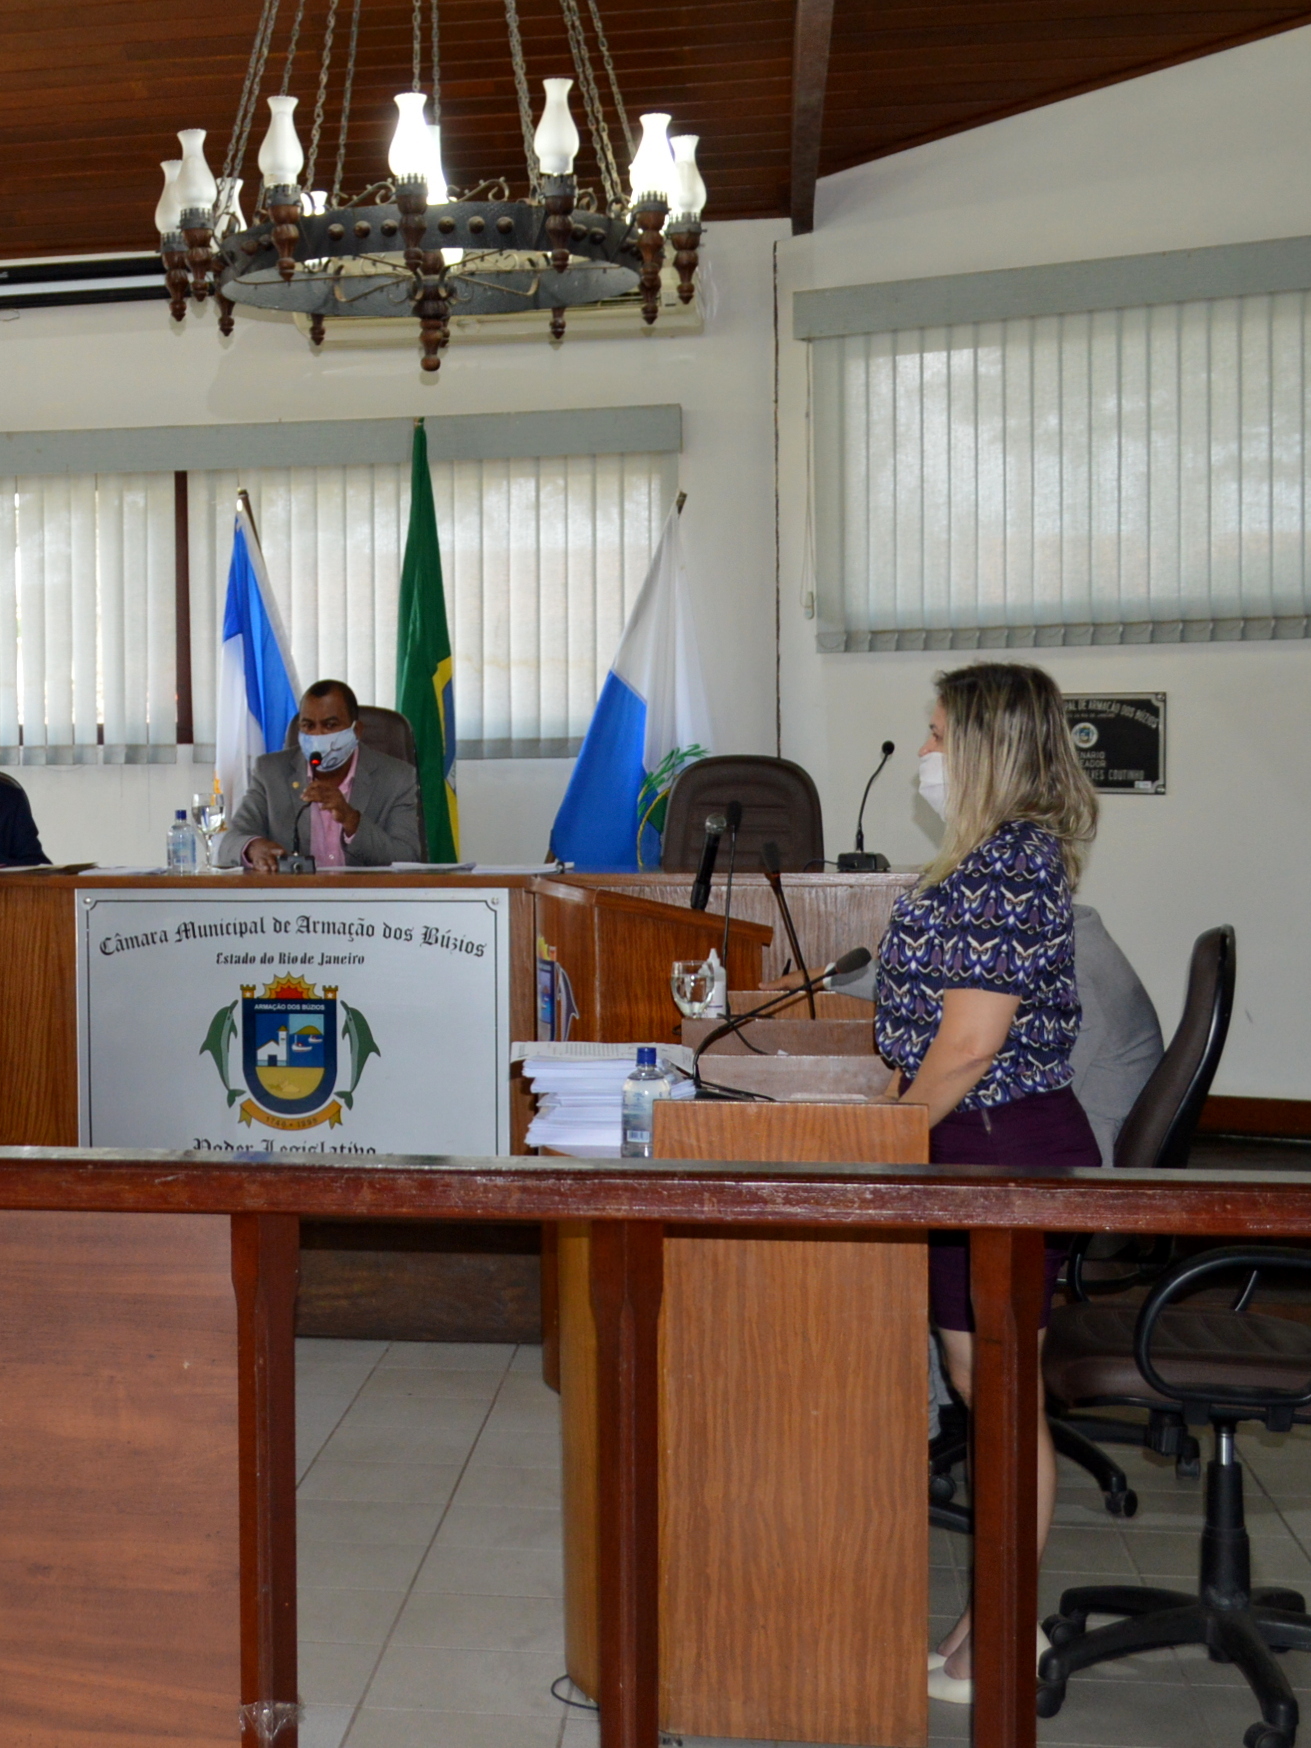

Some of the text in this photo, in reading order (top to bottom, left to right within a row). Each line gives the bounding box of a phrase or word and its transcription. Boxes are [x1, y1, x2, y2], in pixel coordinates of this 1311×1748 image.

[99, 915, 487, 958] Câmara Municipal de Armação dos Búzios
[216, 952, 365, 966] Estado do Rio de Janeiro
[254, 1003, 325, 1011] ARMAÇÃO DOS BÚZIOS
